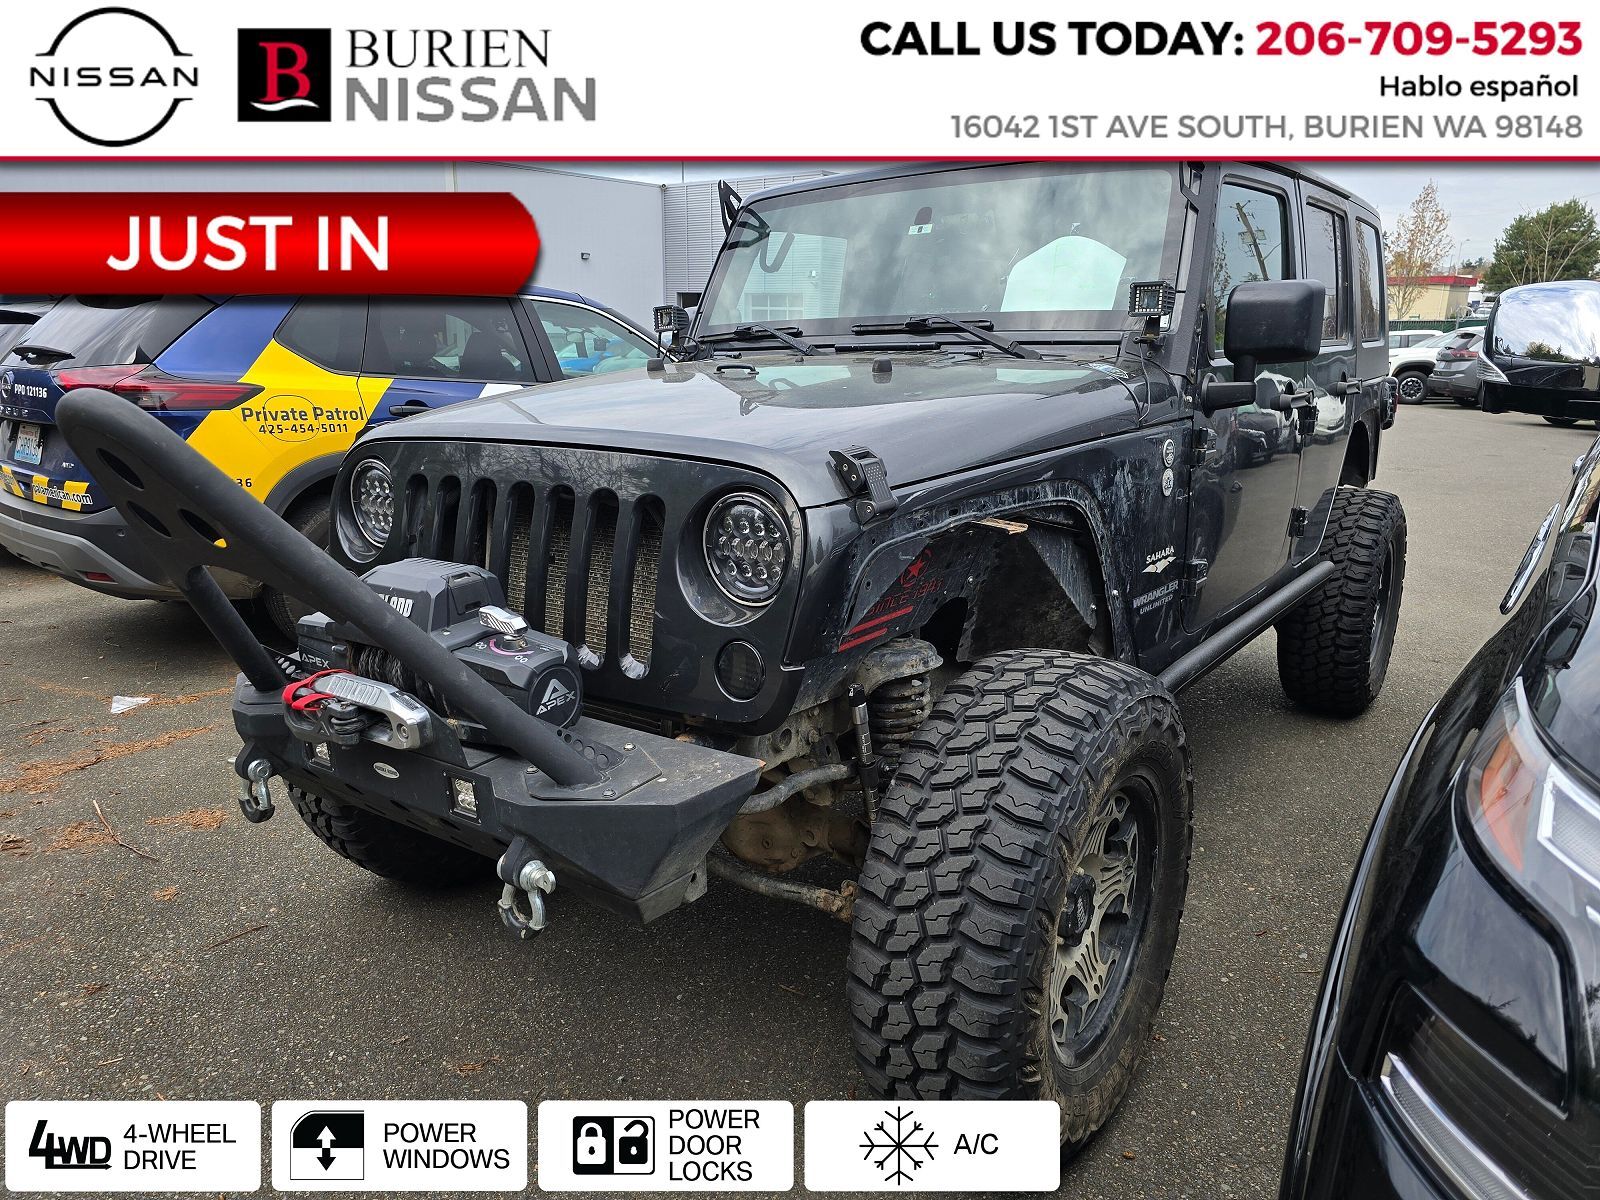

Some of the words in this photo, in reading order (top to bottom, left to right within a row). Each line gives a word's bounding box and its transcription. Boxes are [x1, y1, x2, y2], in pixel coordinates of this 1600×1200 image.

[26, 386, 48, 399] 121136
[241, 406, 308, 422] Private
[312, 406, 364, 421] Patrol
[258, 423, 348, 434] 425-454-5011
[1146, 545, 1175, 564] SAHARA
[1133, 580, 1179, 608] WRANGLER
[1140, 594, 1173, 615] UNLIMITED
[301, 653, 331, 669] APEX
[535, 690, 576, 716] APEX
